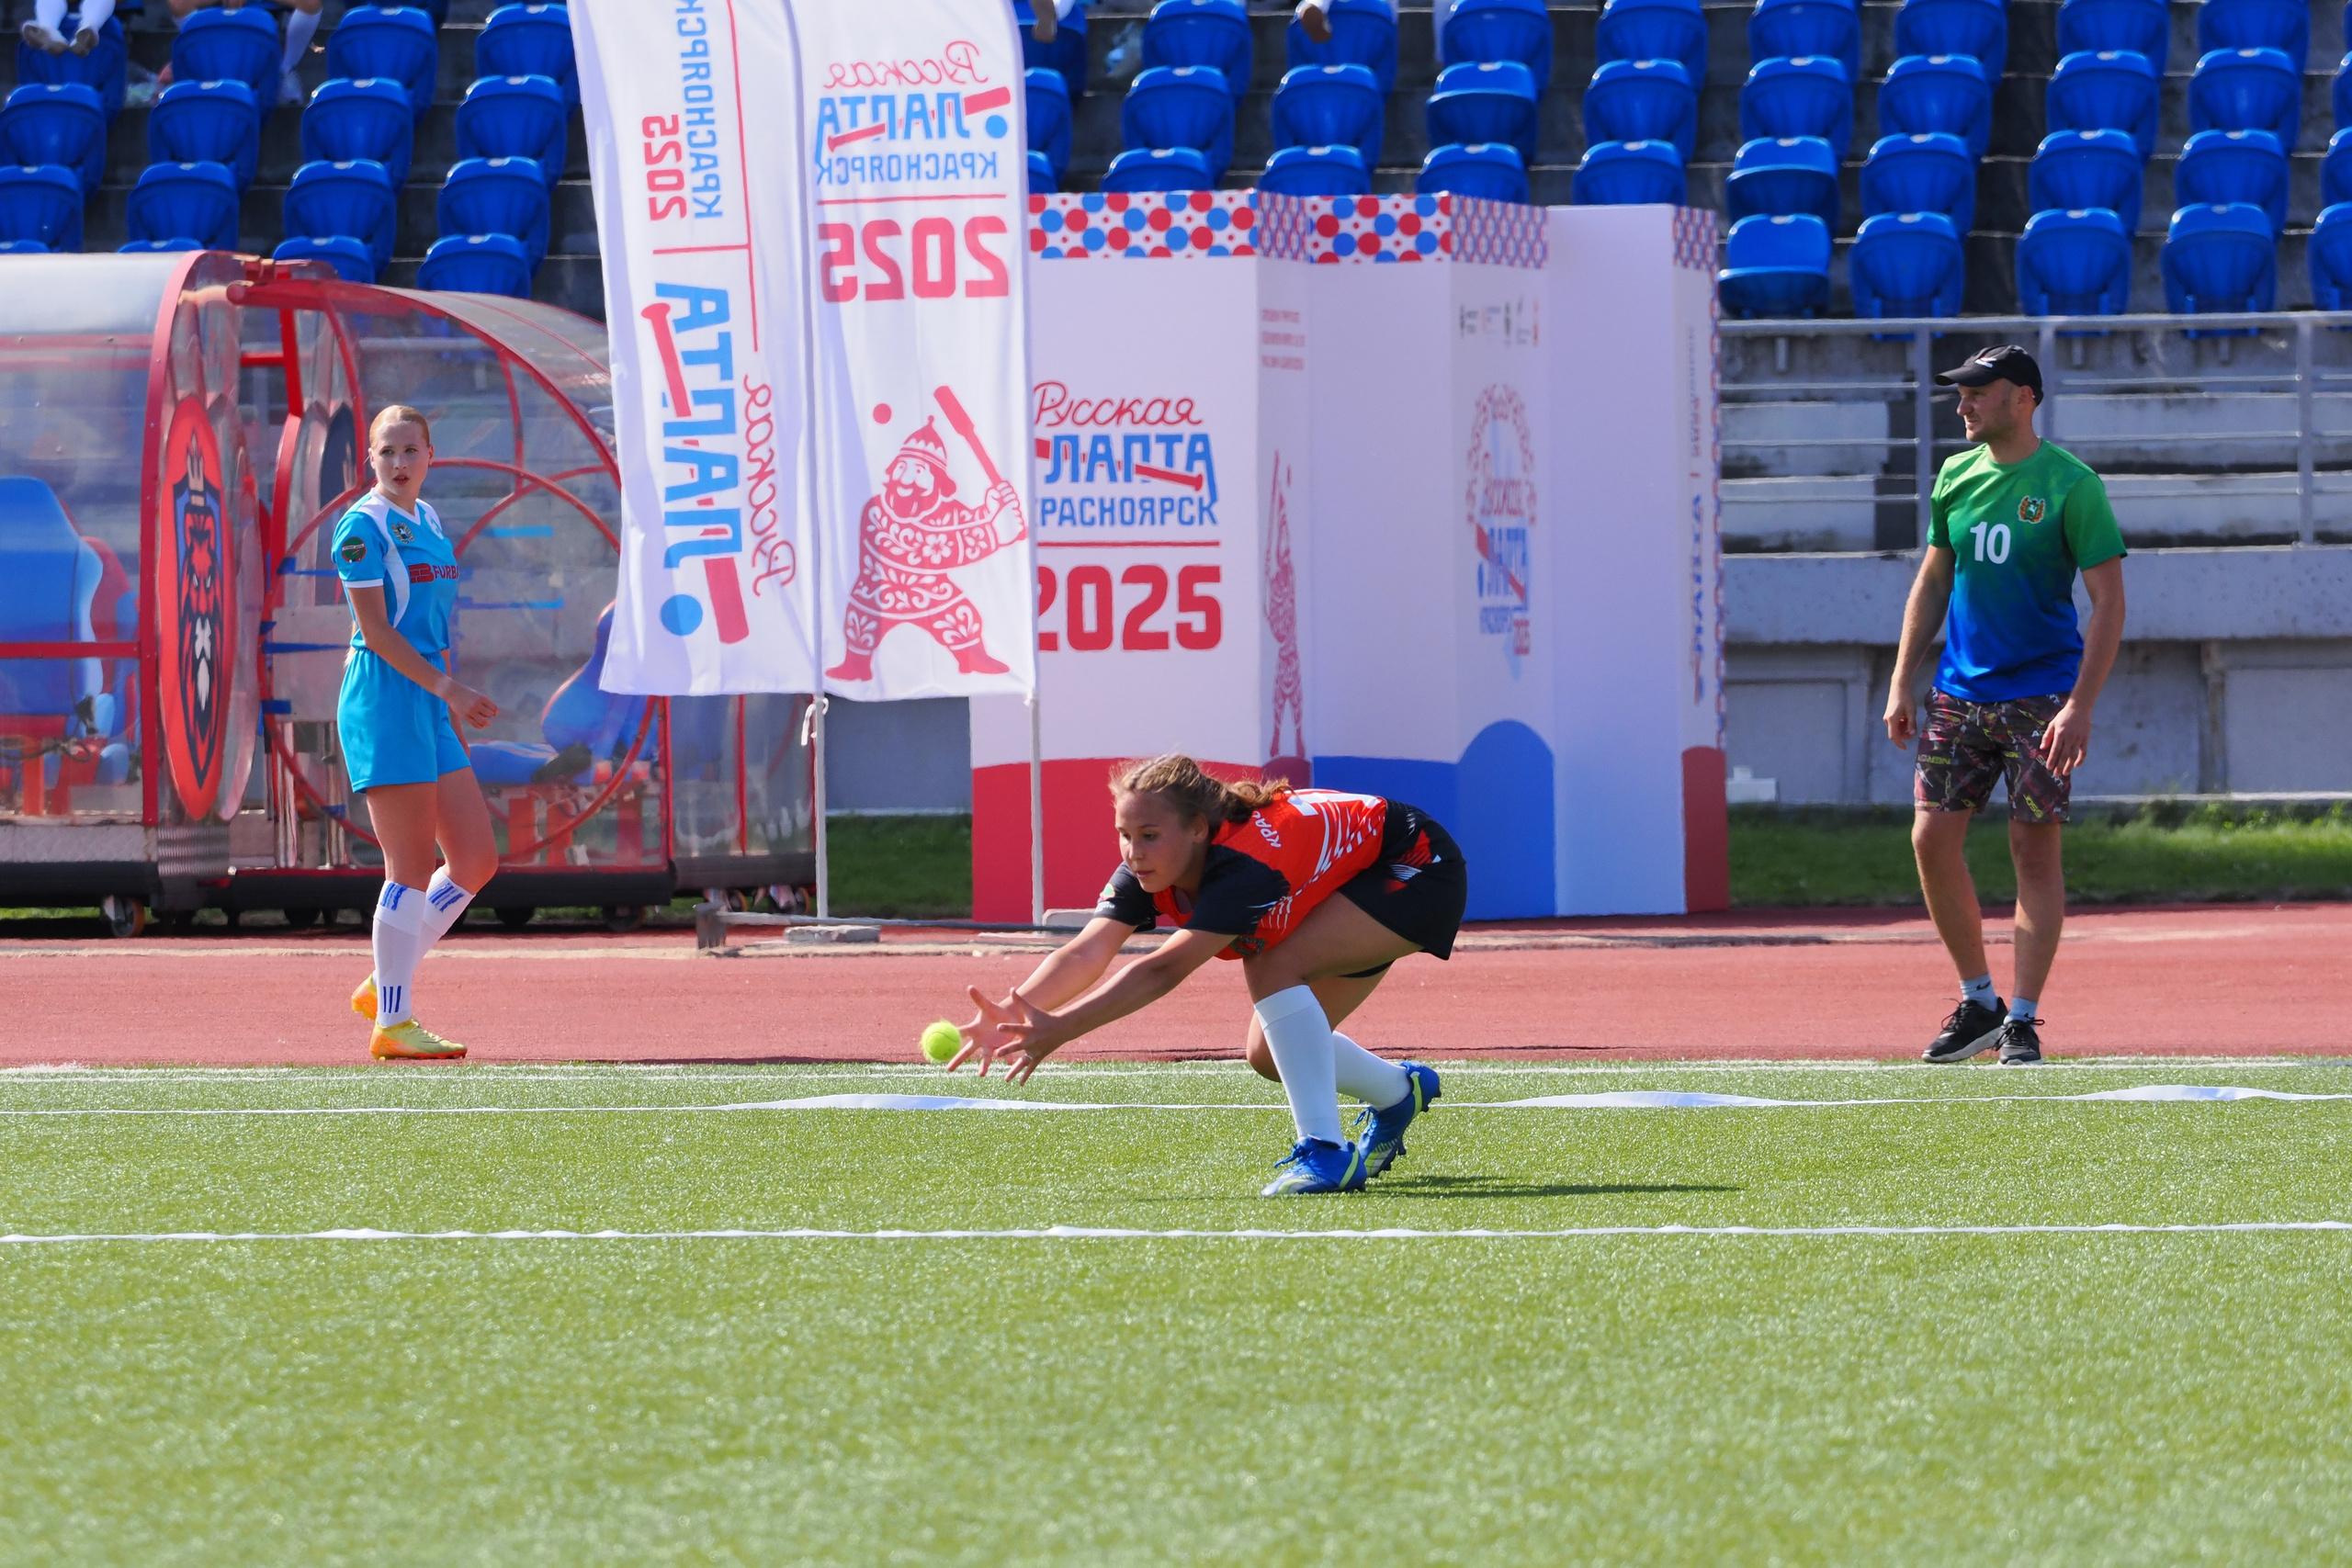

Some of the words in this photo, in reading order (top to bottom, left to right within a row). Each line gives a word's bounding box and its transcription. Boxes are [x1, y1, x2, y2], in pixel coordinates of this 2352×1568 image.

[1035, 380, 1204, 427] Русская
[1044, 434, 1218, 502] ЛАПТА
[1040, 497, 1218, 526] РАСНОЯРСК
[1970, 521, 2011, 565] 10
